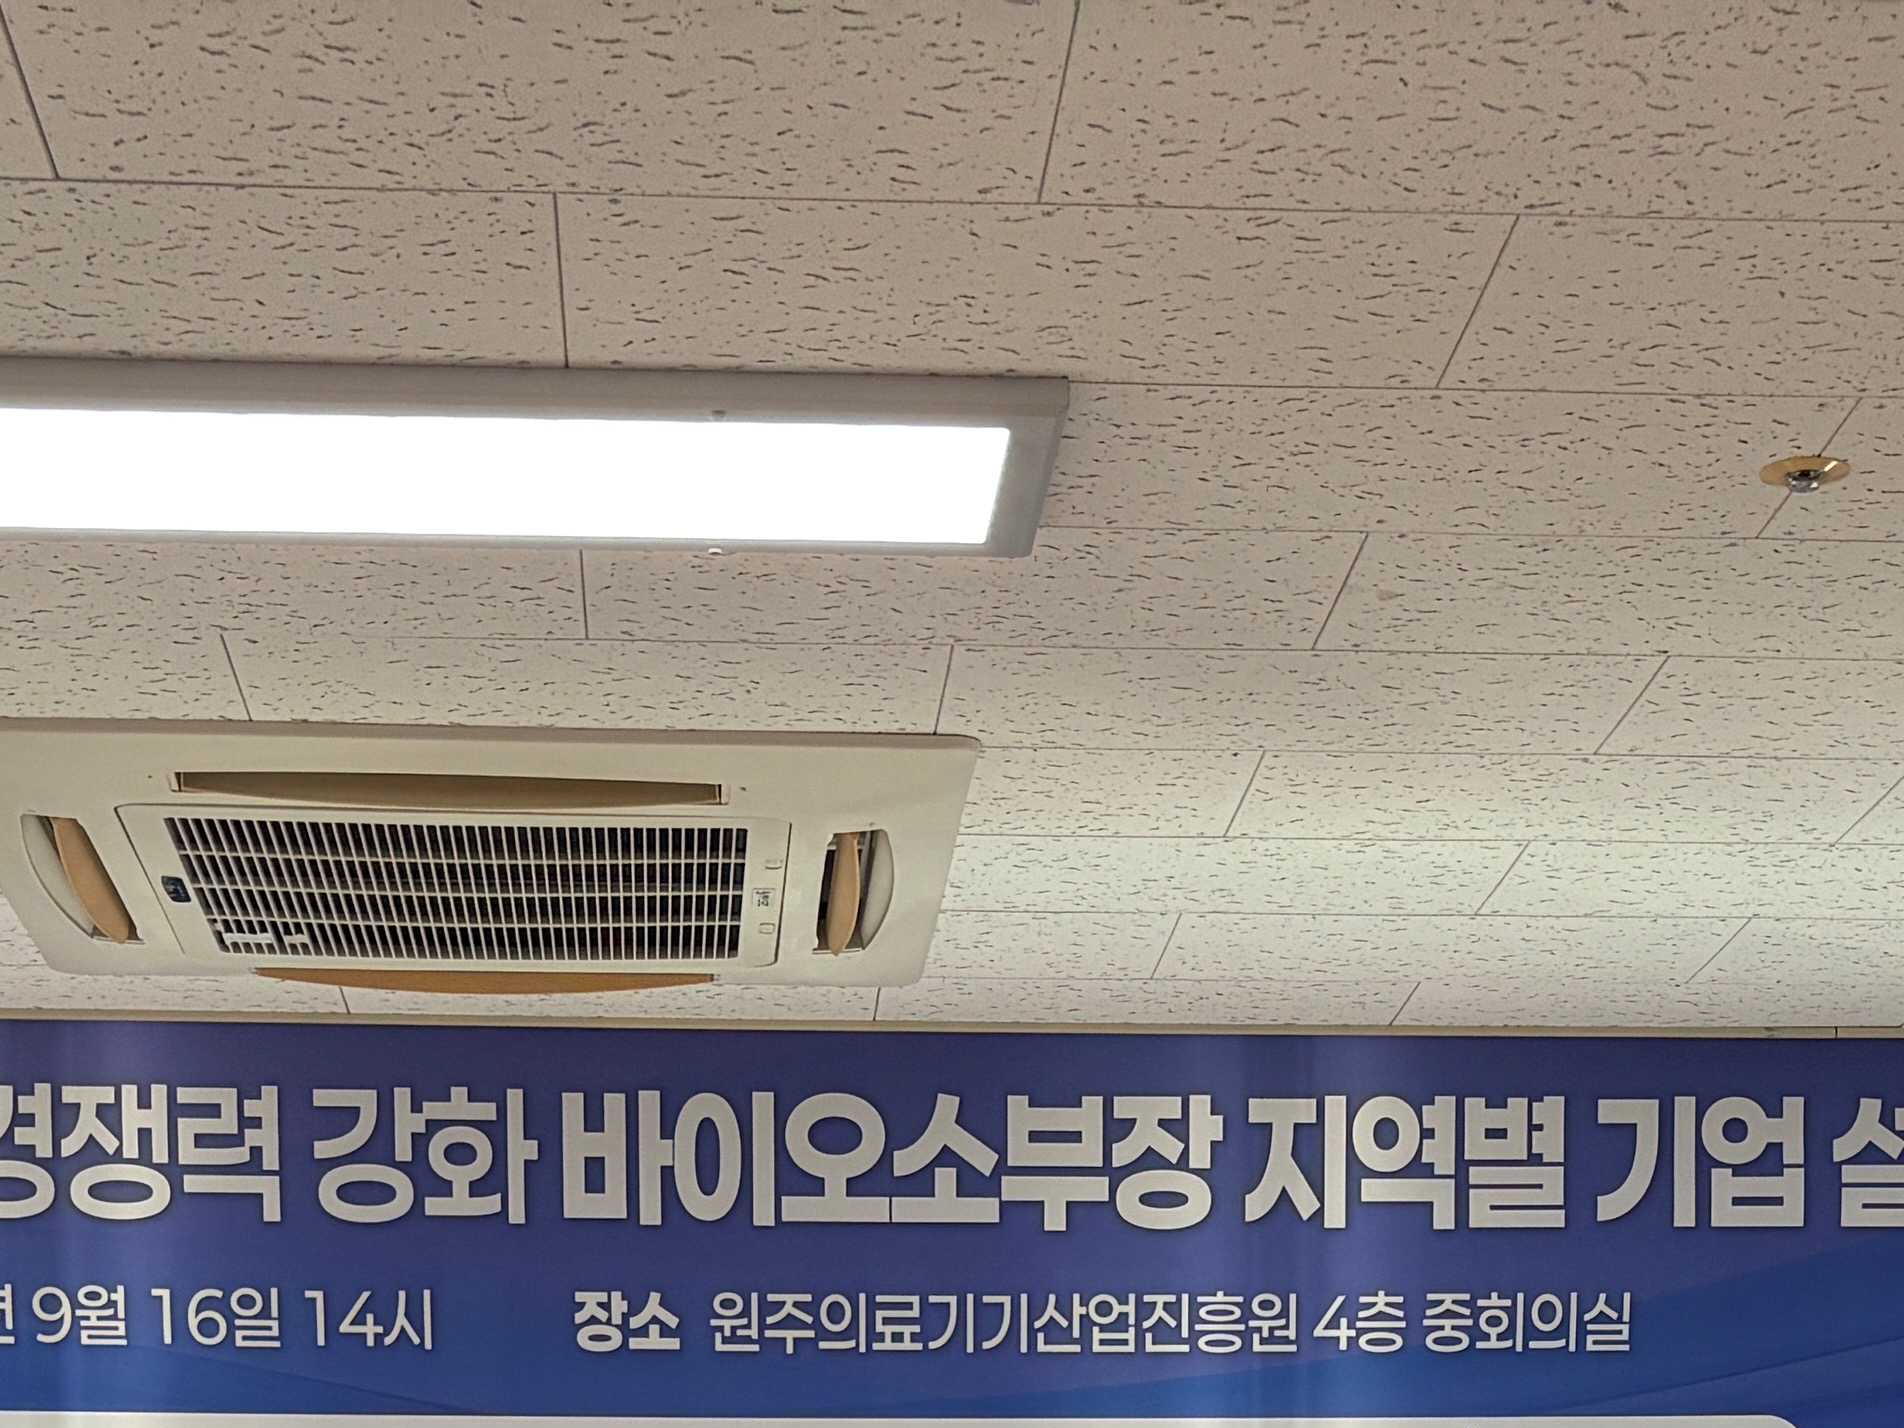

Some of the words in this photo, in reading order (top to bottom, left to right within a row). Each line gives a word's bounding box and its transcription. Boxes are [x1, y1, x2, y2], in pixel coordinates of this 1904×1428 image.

[312, 1087, 539, 1224] 강화
[562, 1091, 1224, 1231] 바이오소부장
[1244, 1095, 1566, 1230] 지역별
[1596, 1096, 1805, 1227] 기업
[32, 1284, 128, 1346] 9월
[150, 1287, 281, 1348] 16일
[304, 1289, 433, 1350] 14시
[574, 1291, 681, 1352] 장소
[710, 1290, 1298, 1354] 원주의료기기산업진흥원
[1313, 1290, 1407, 1353] 4층
[1422, 1291, 1631, 1353] 중회의실
